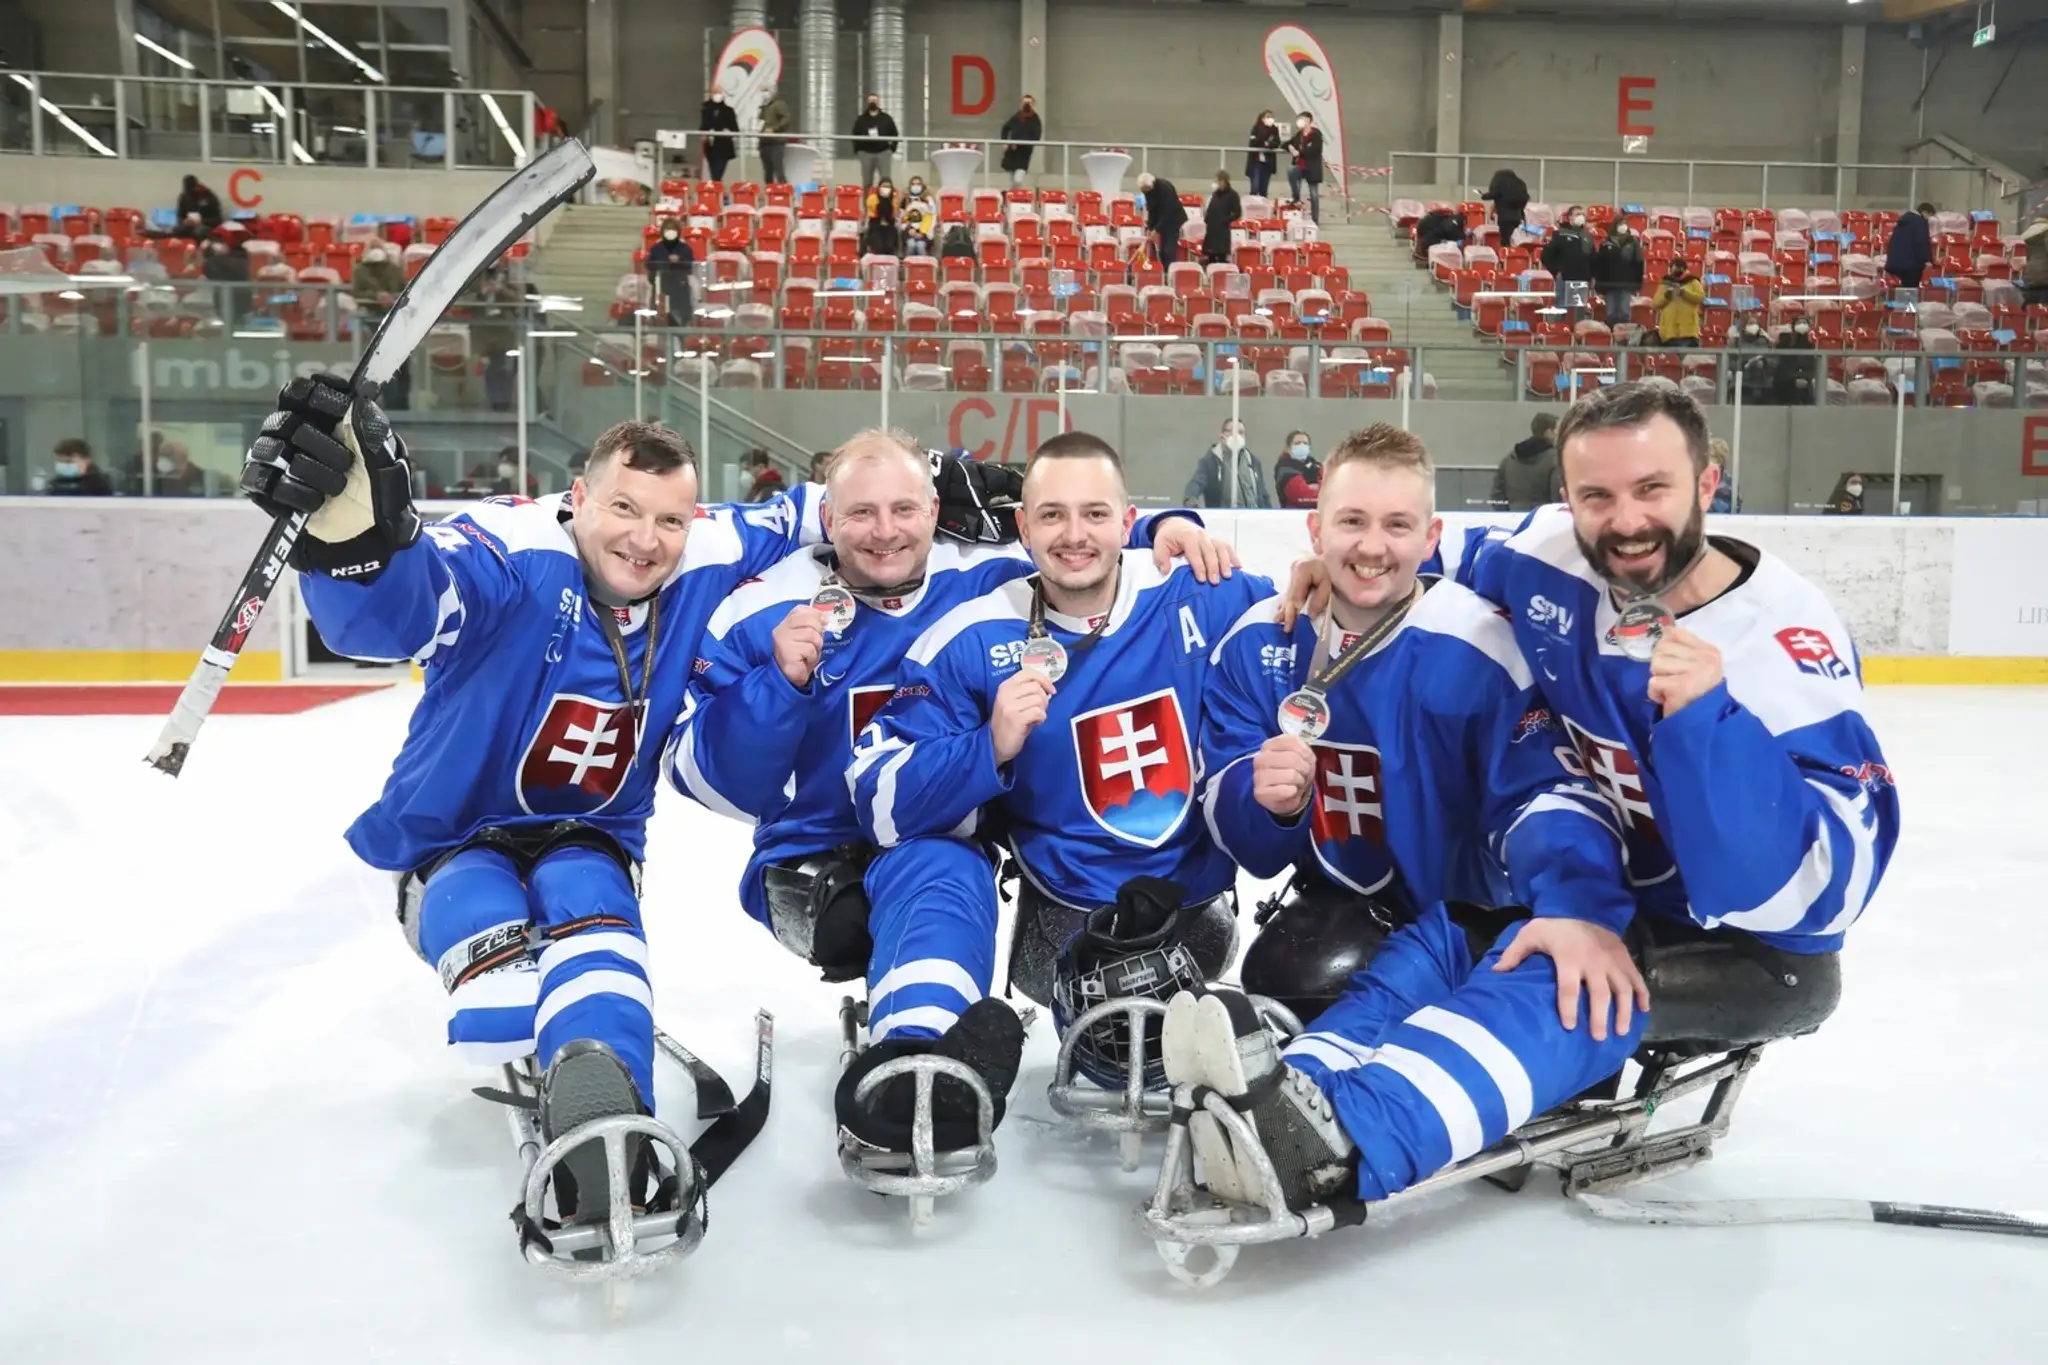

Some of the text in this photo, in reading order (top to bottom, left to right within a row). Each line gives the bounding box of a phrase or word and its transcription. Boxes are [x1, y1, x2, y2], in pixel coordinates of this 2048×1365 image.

[951, 55, 995, 115] D
[1617, 77, 1655, 136] E
[228, 169, 264, 208] C
[949, 398, 1071, 464] C/D
[2024, 417, 2048, 476] E
[331, 560, 382, 577] CCM
[1178, 605, 1206, 654] A
